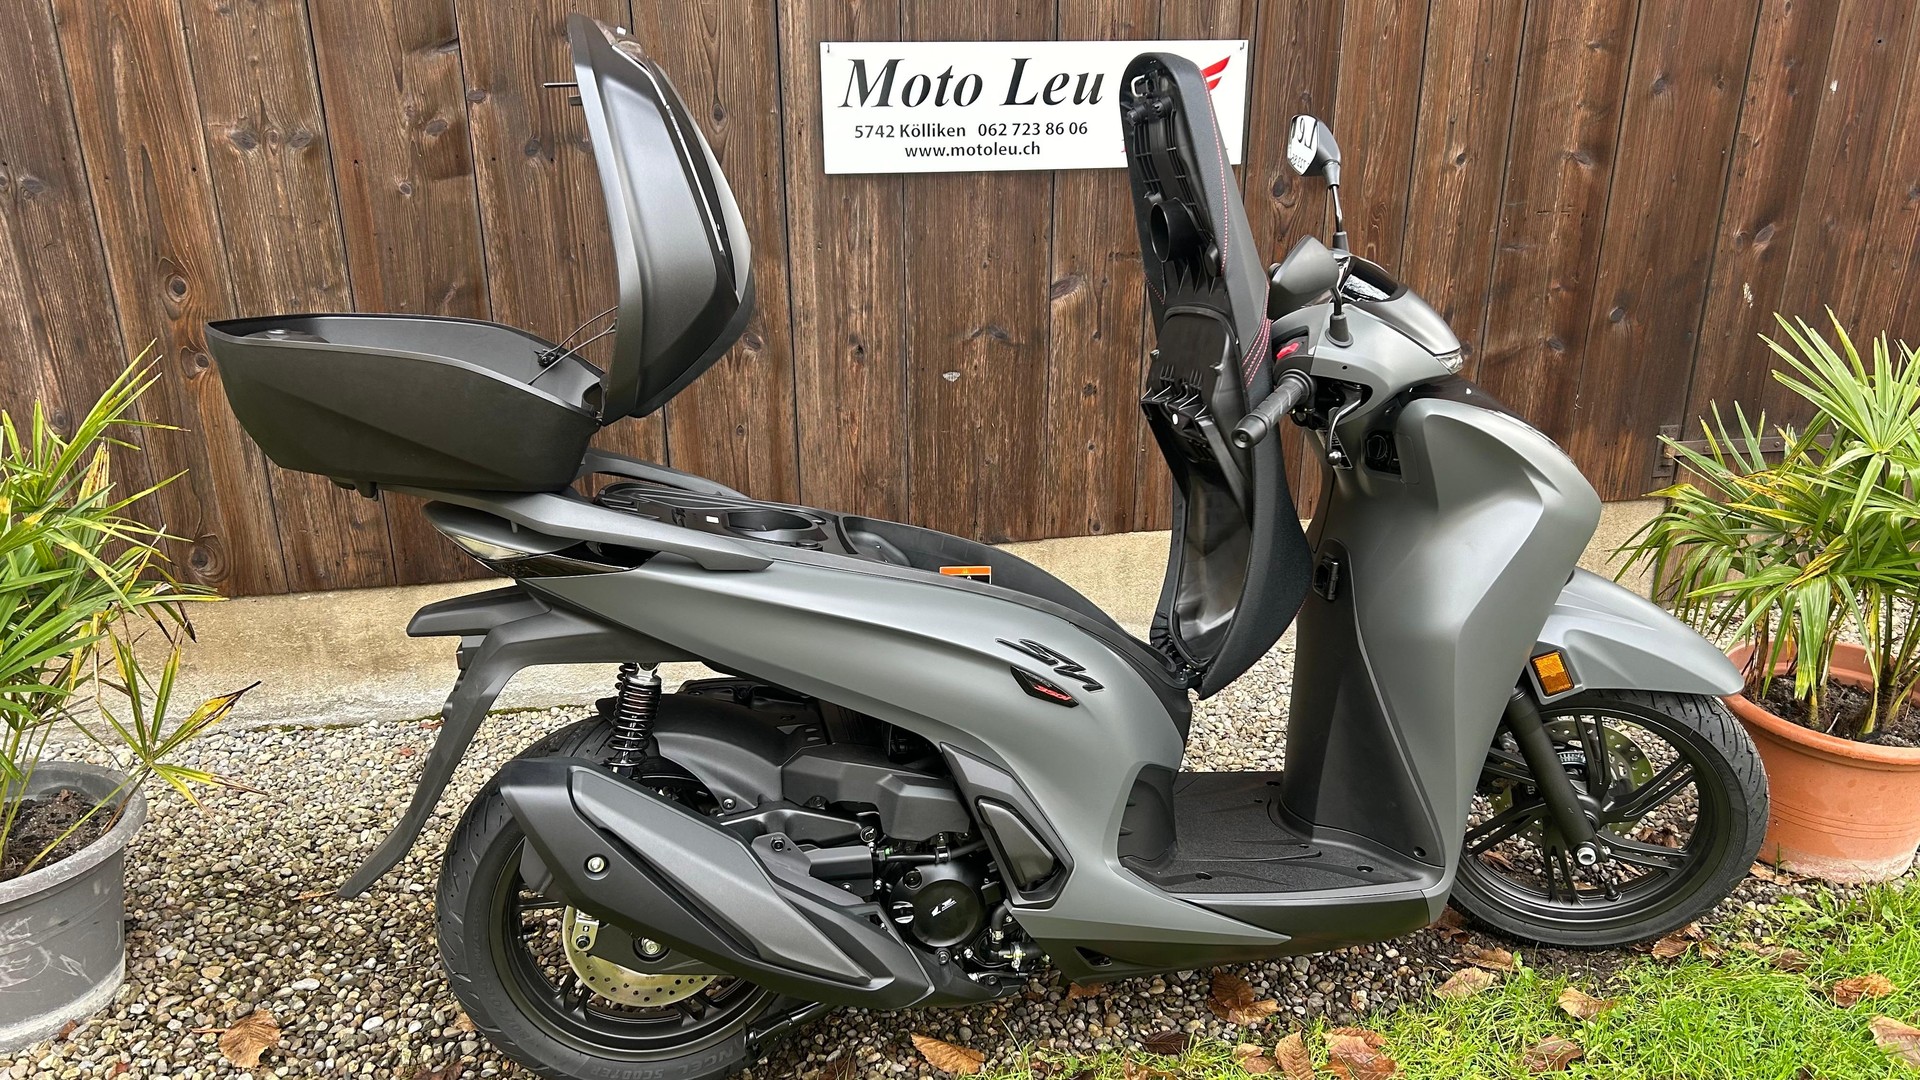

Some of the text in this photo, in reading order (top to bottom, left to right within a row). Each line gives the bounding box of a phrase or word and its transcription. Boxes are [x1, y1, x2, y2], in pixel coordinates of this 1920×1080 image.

[838, 57, 1105, 108] Moto Leu
[854, 121, 1088, 139] 5742 Kölliken 062 723 86 06
[904, 140, 1041, 158] www.motoleu.ch
[590, 1065, 665, 1080] SCOOTER
